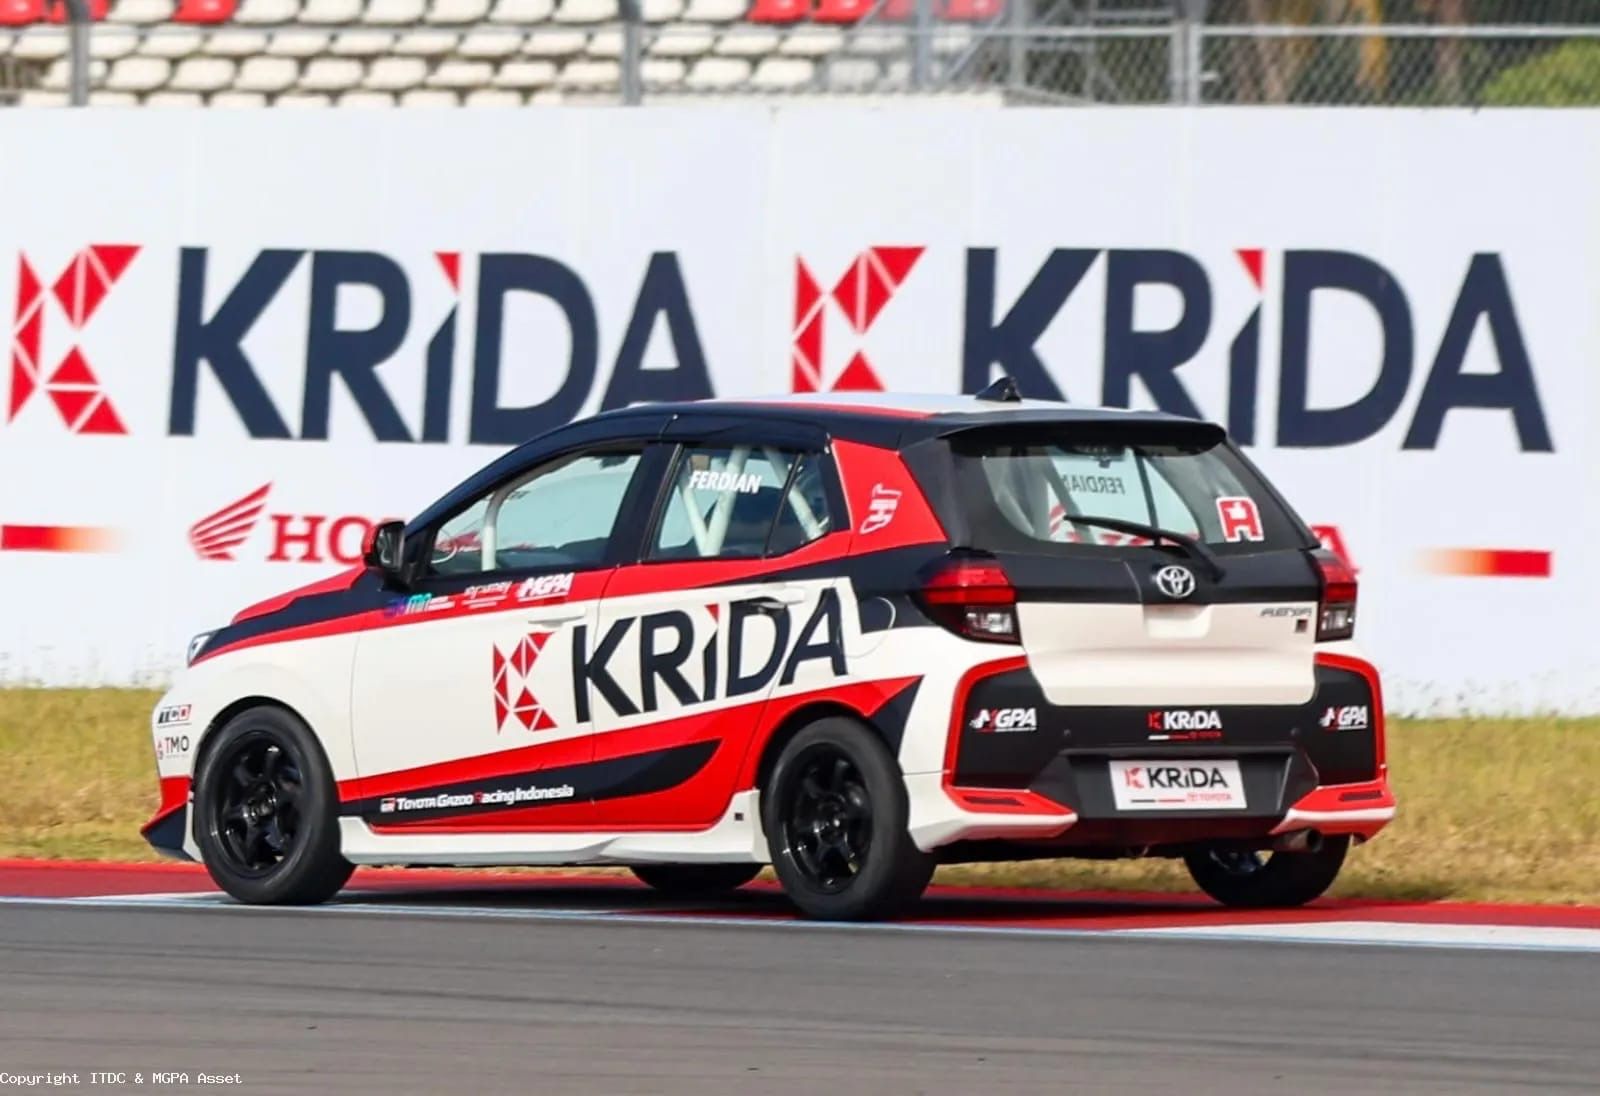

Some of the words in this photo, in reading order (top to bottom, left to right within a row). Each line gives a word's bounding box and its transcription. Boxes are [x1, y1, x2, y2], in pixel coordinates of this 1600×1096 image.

[688, 470, 762, 494] FERDIAN
[516, 572, 575, 600] MGPA
[165, 735, 189, 752] TMO
[474, 788, 515, 806] Racing
[515, 784, 574, 801] Indonesia
